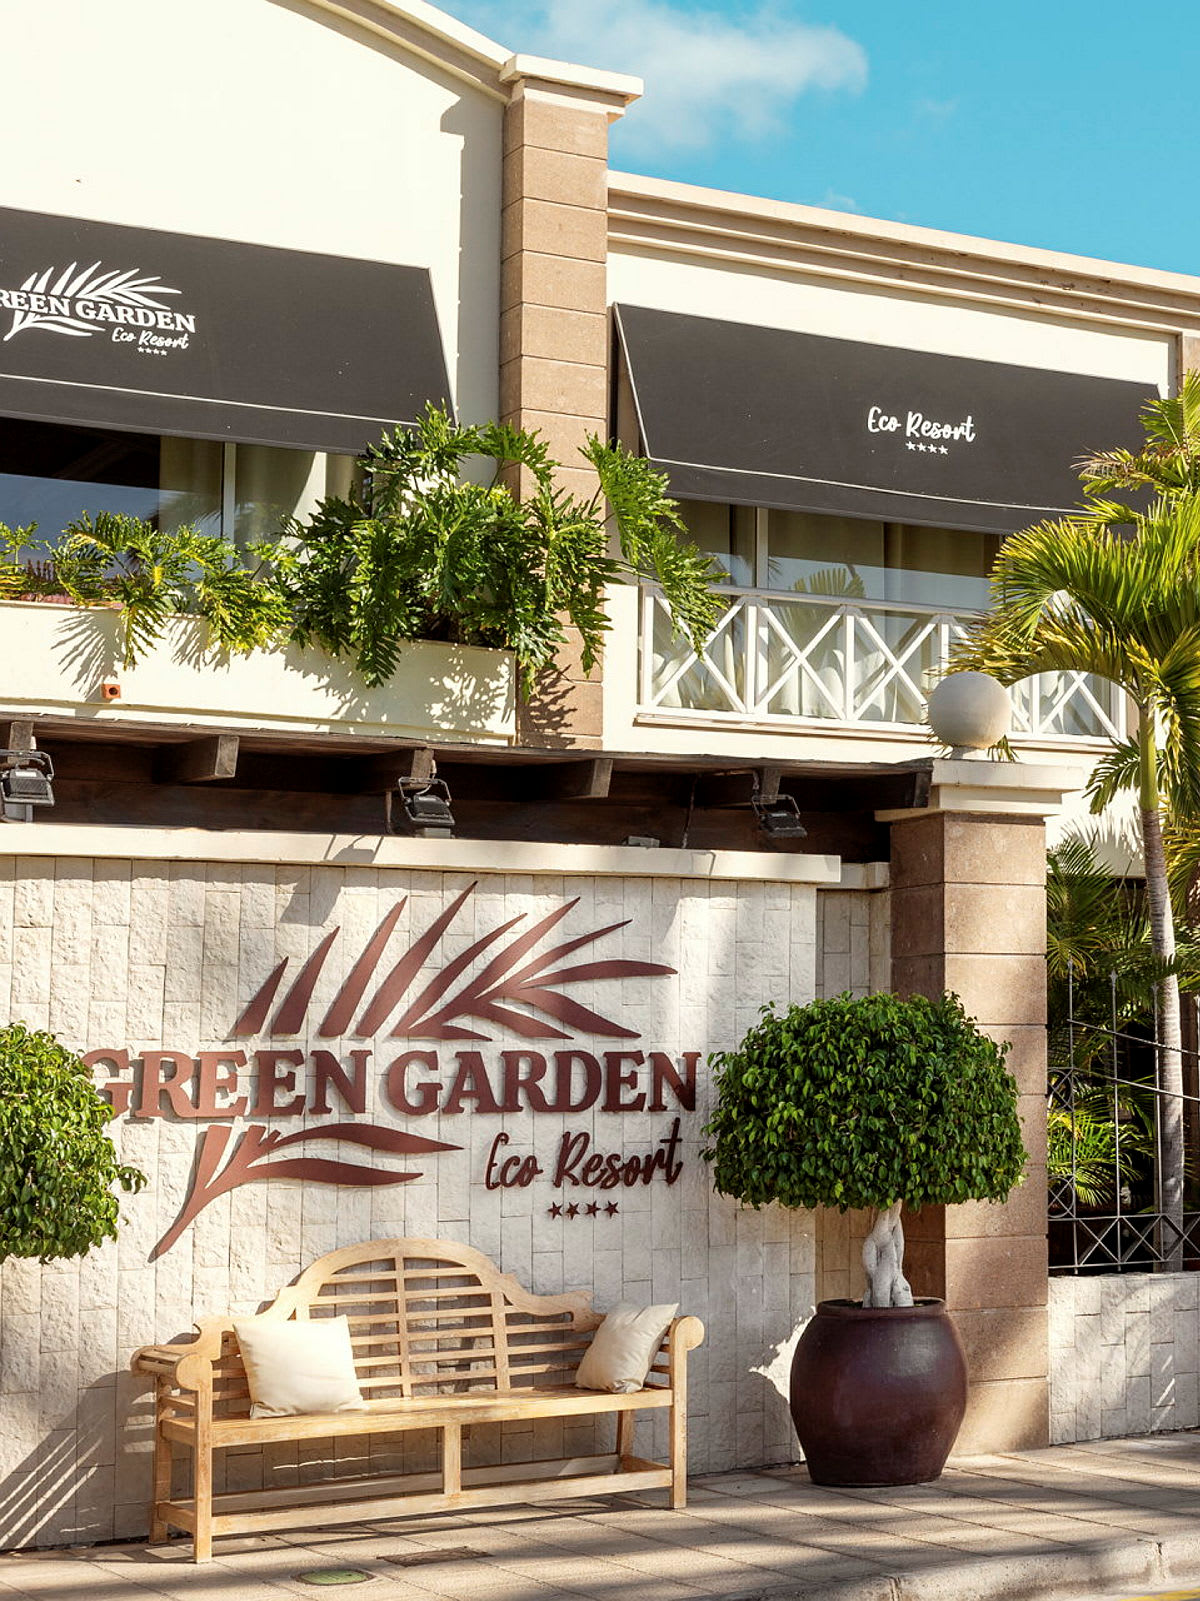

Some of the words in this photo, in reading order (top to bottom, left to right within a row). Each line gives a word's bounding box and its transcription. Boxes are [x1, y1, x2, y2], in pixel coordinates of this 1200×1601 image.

[0, 289, 71, 317] REEN
[76, 300, 196, 333] GARDEN
[112, 327, 137, 343] Eco
[139, 330, 190, 349] Resort
[867, 406, 902, 433] Eco
[905, 411, 976, 442] Resort
[80, 1048, 373, 1120] GREEN
[388, 1050, 702, 1115] GARDEN
[485, 1132, 543, 1190] Eco
[554, 1117, 683, 1189] Resort
